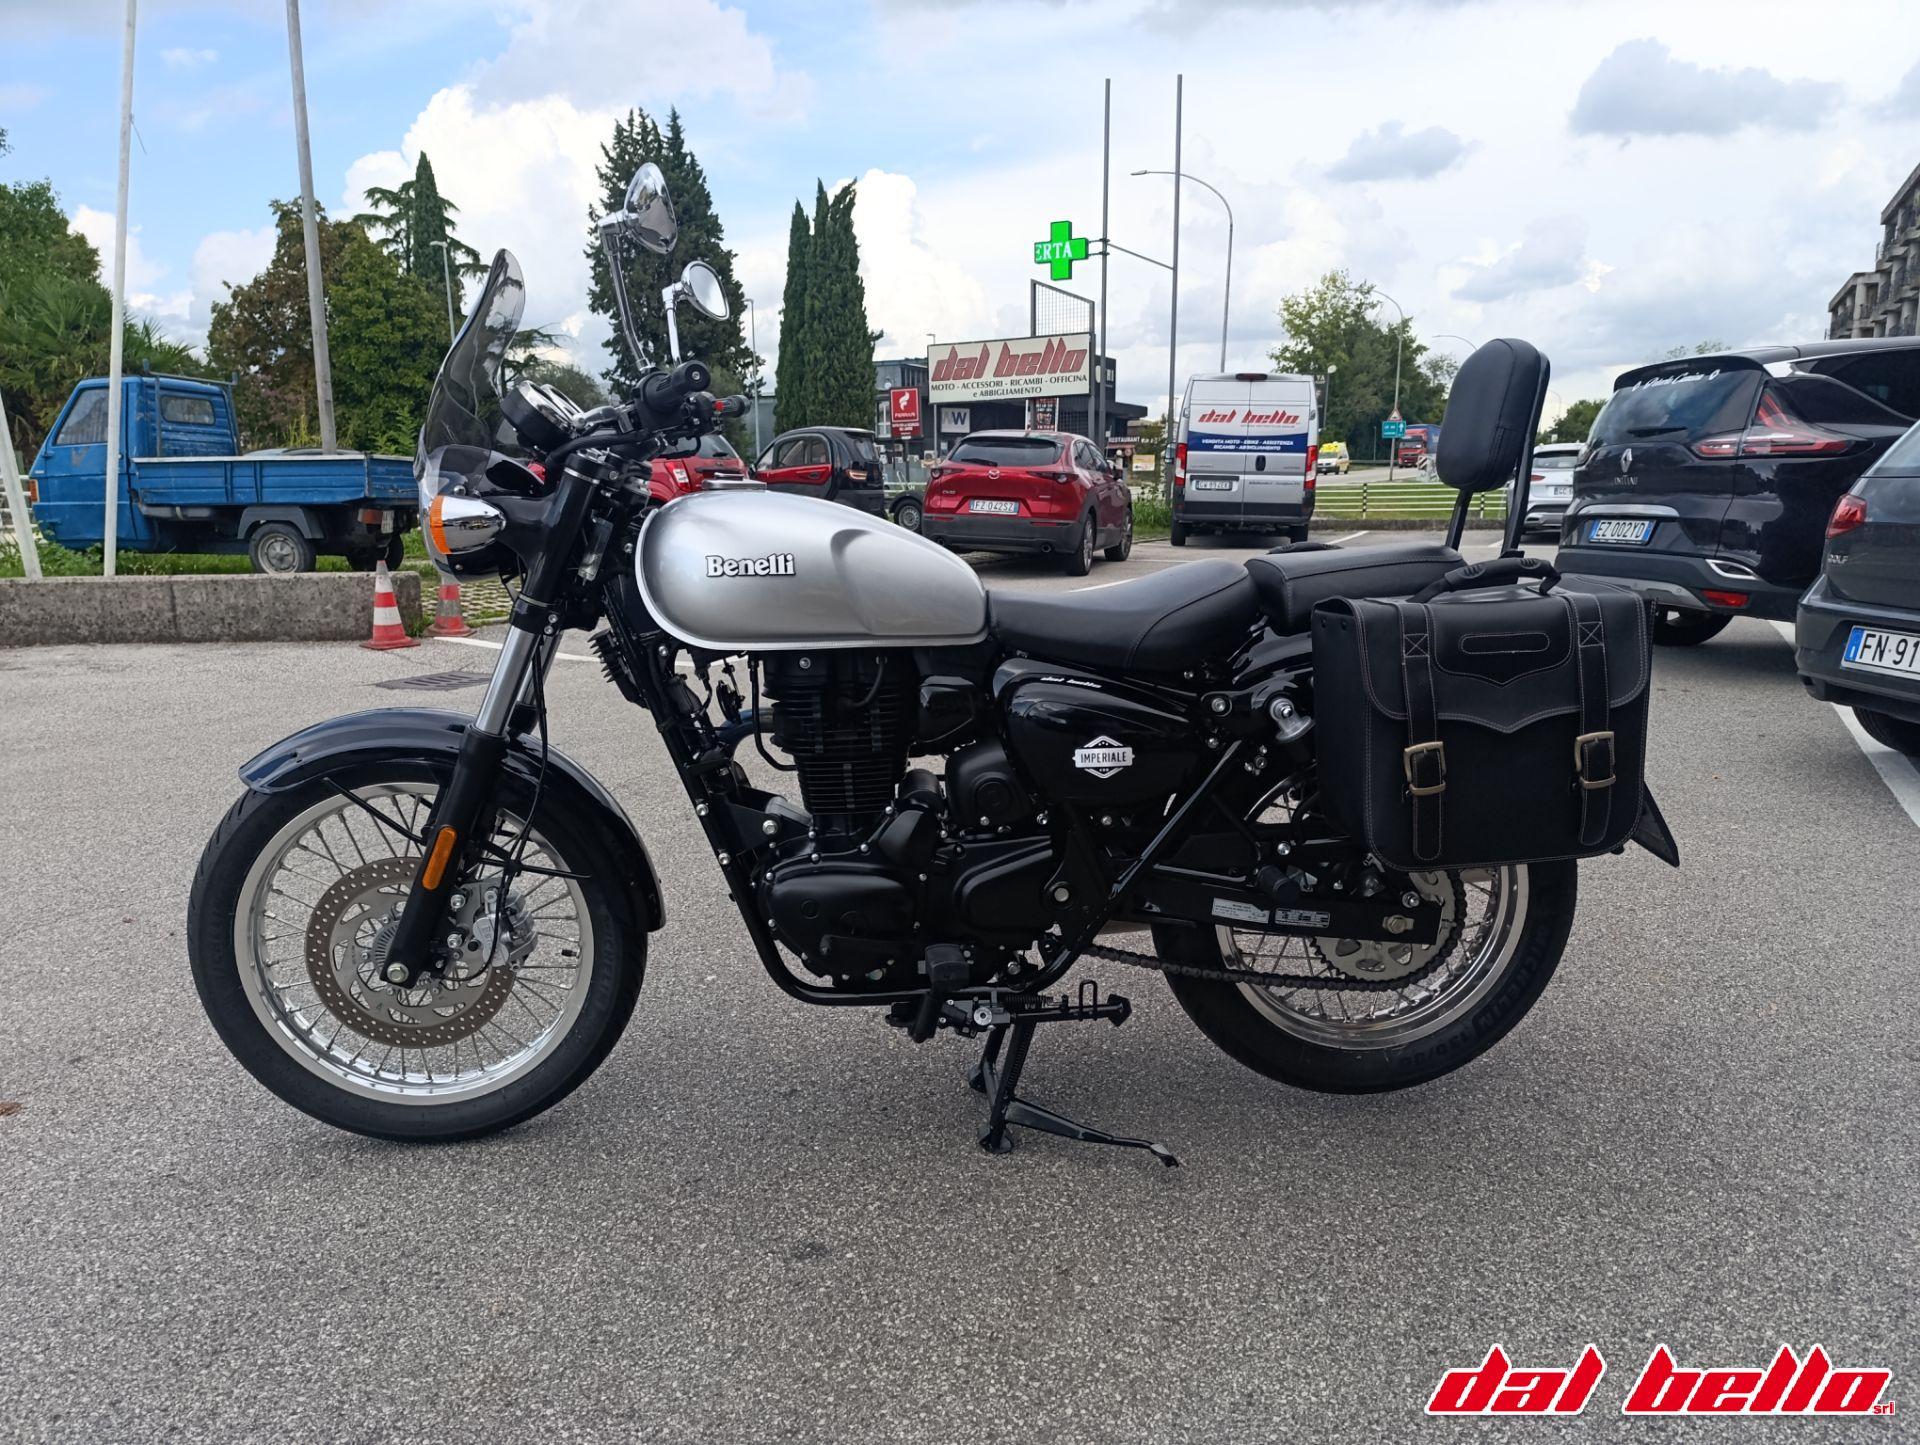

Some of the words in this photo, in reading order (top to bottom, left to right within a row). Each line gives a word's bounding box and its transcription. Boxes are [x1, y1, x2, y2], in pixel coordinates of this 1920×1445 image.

[931, 343, 990, 381] dal
[993, 337, 1088, 378] bello
[961, 381, 1004, 390] ACCESSORI
[1010, 378, 1043, 386] RICAMBI
[1050, 375, 1088, 384] OFFICINA
[979, 387, 1042, 397] ABBIGLIAMENTO
[1198, 409, 1237, 423] dal
[1241, 409, 1300, 424] bello
[705, 553, 796, 577] Benelli
[1080, 751, 1127, 763] IMPERIALE
